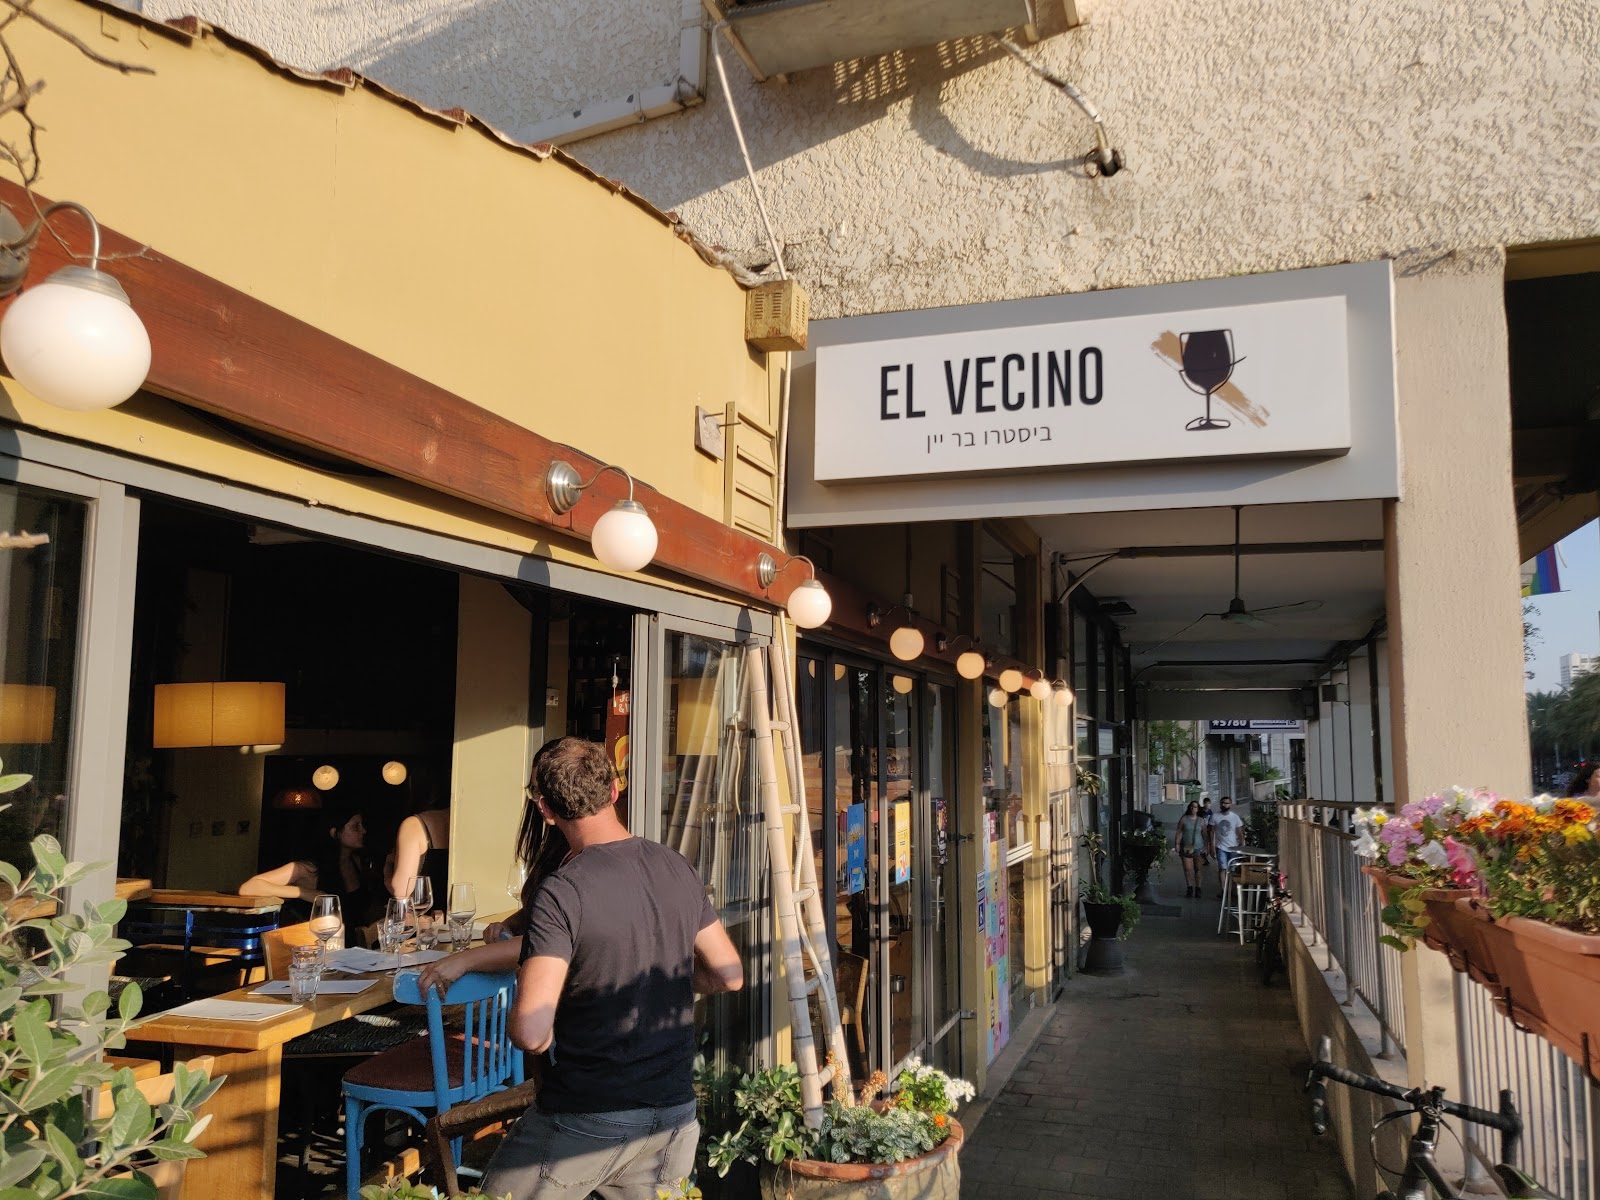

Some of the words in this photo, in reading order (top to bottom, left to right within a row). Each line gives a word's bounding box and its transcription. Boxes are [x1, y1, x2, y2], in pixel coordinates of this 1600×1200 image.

[880, 363, 926, 420] EL
[944, 346, 1103, 415] VECINO
[927, 433, 943, 454] יין
[952, 432, 976, 448] בר
[984, 426, 1052, 446] ביסטרו
